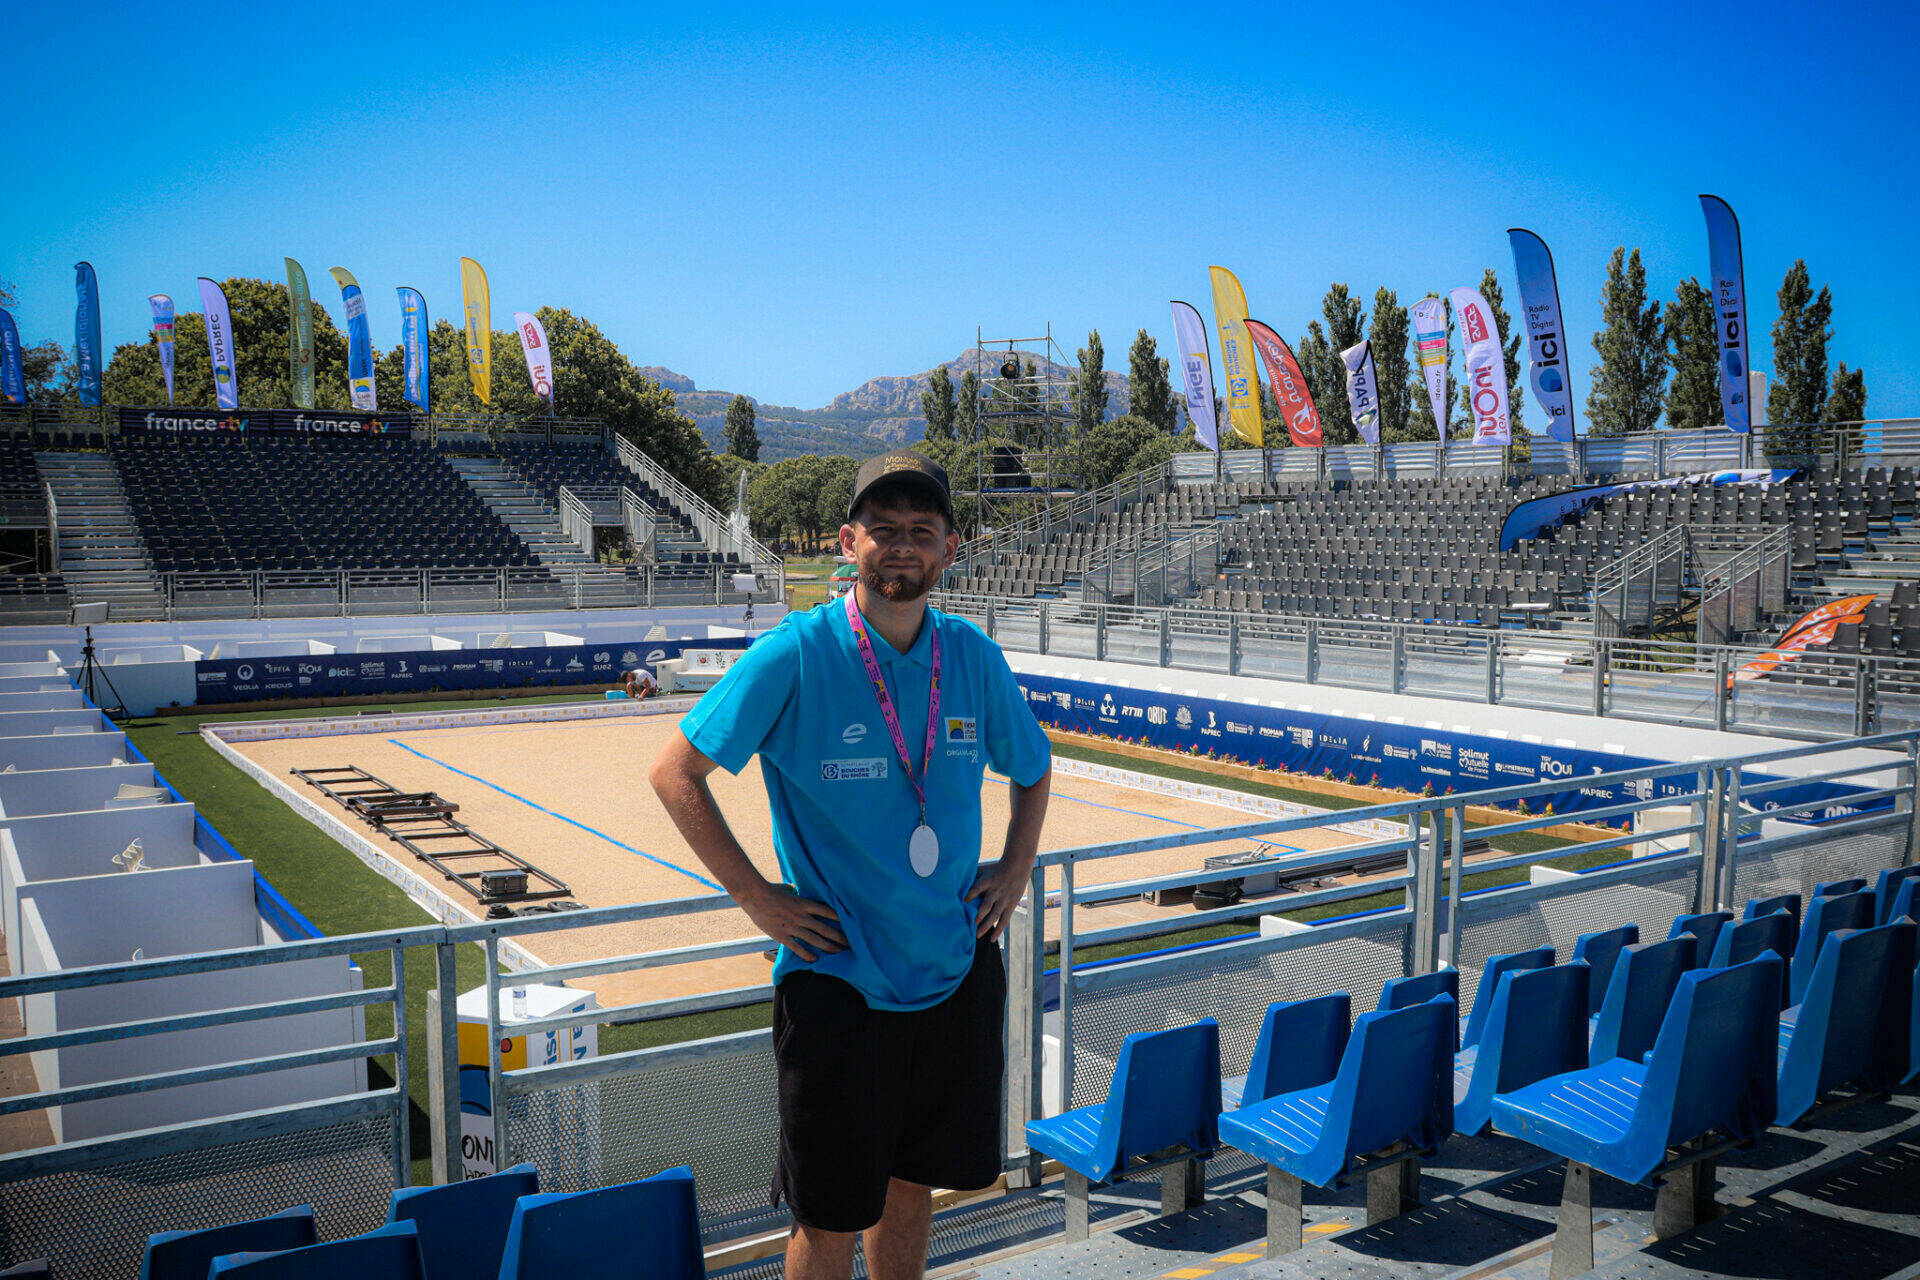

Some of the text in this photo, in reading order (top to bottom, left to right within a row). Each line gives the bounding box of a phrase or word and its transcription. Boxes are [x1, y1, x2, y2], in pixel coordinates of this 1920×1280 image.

[1529, 304, 1550, 314] Radio
[1530, 314, 1540, 322] TV
[1531, 319, 1555, 330] Digital
[1723, 312, 1740, 349] ici
[1534, 333, 1560, 369] ici
[1551, 405, 1566, 417] ici
[1147, 705, 1168, 725] OBUT
[1259, 727, 1284, 737] PROMAN
[1458, 748, 1490, 760] Solimut
[1474, 766, 1489, 774] France
[1541, 759, 1573, 776] inOui
[1580, 787, 1613, 799] PAPREC
